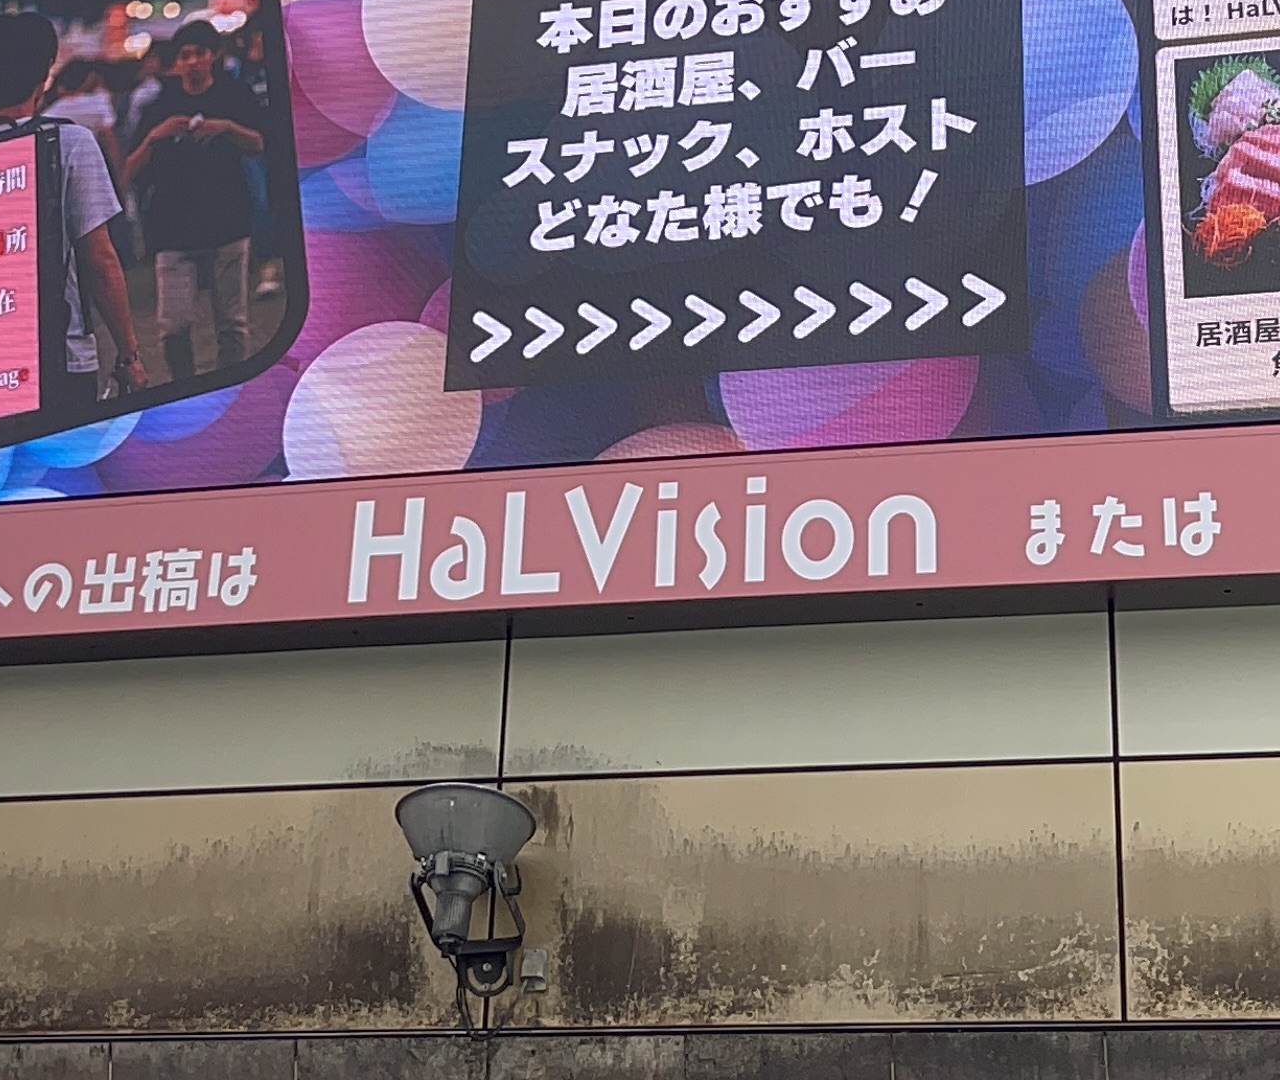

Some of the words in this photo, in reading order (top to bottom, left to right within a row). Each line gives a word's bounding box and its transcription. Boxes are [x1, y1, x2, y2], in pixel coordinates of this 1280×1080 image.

[529, 169, 939, 252] どなた様でも！
[347, 476, 937, 604] HaLVision
[1025, 491, 1221, 566] または
